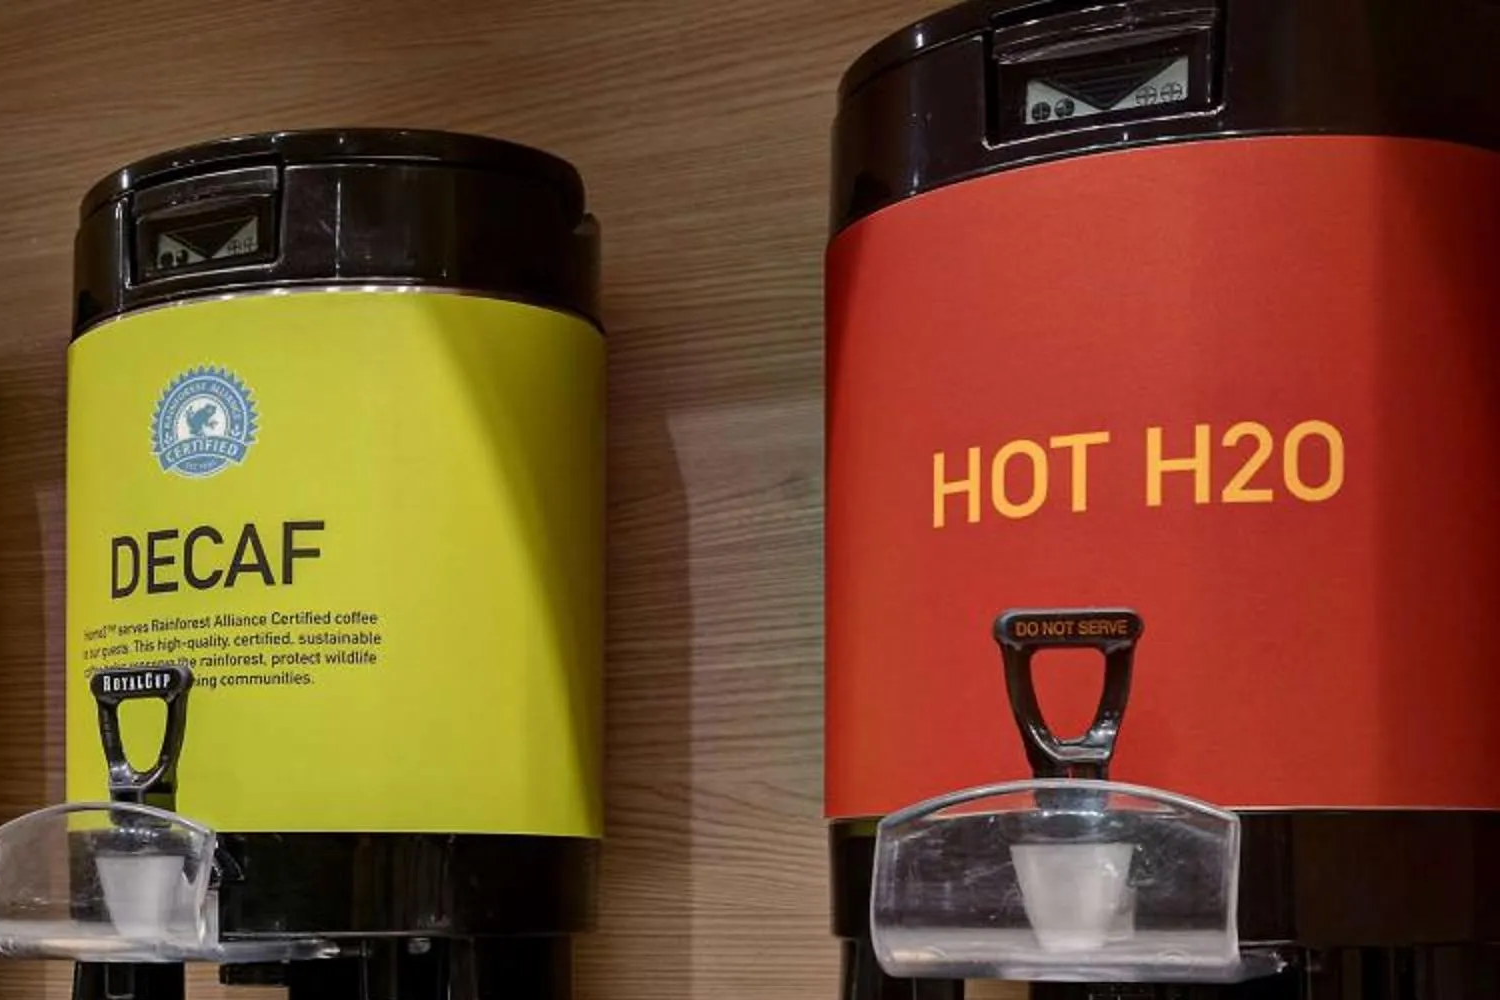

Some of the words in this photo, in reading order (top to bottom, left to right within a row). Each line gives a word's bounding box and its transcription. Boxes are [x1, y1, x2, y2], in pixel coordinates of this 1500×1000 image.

[165, 441, 239, 464] CERTIFIED
[933, 431, 1110, 528] HOT
[111, 520, 325, 600] DECAF
[151, 617, 211, 632] Rainforest
[213, 613, 267, 628] Alliance
[271, 610, 331, 625] Certified
[335, 610, 378, 625] coffee
[1015, 621, 1039, 637] DO
[1043, 620, 1075, 636] NOT
[1078, 619, 1128, 636] SERVE
[134, 639, 156, 653] This
[298, 631, 382, 646] sustainable
[271, 651, 321, 668] protect
[325, 650, 377, 665] wildlife
